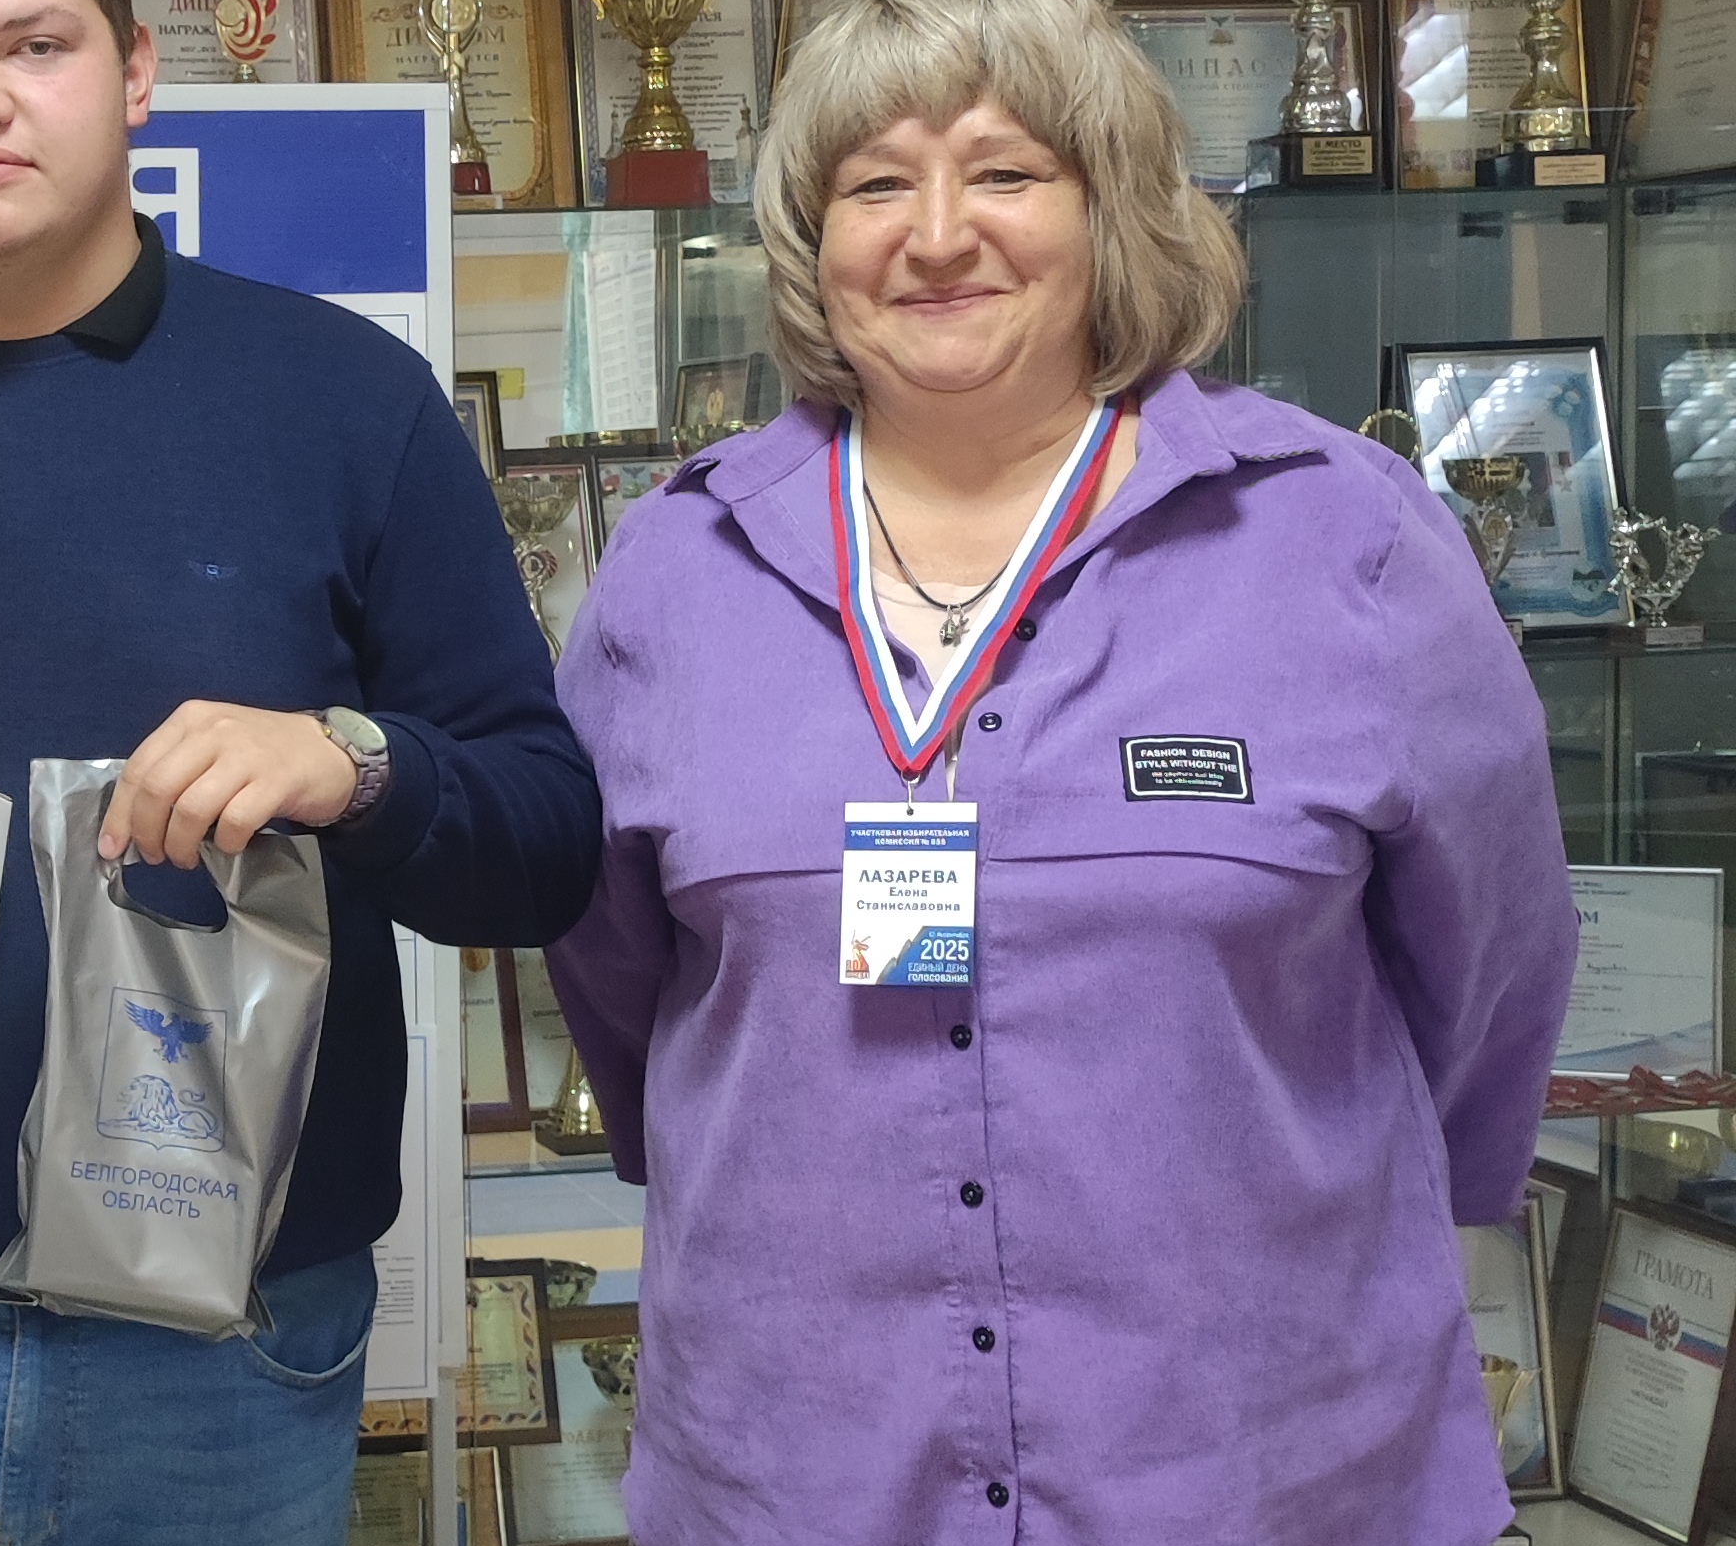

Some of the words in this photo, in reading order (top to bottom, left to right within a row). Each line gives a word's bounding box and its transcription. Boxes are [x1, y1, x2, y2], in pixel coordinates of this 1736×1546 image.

[1140, 748, 1187, 758] FASHION
[1192, 748, 1231, 760] DESIGN
[1135, 760, 1169, 770] STYLE
[1169, 759, 1216, 770] WITHOUT
[1218, 762, 1238, 773] THE
[850, 829, 902, 837] УЧАСТКОВАЯ
[902, 828, 970, 837] ИЗБИРАТЕЛЬНАЯ
[874, 838, 920, 846] КОМИССИЯ
[858, 869, 959, 884] ЛАЗАРЕВА
[889, 886, 928, 897] Елена
[856, 899, 961, 912] Станиславовна
[920, 938, 970, 961] 2025
[907, 973, 969, 983] ГОЛОСОВАНИЯ
[70, 1161, 239, 1202] БЕЛГОРОДСКАЯ
[102, 1190, 201, 1219] ОБЛАСТЬ
[1633, 1249, 1714, 1300] ГРАМОТА
